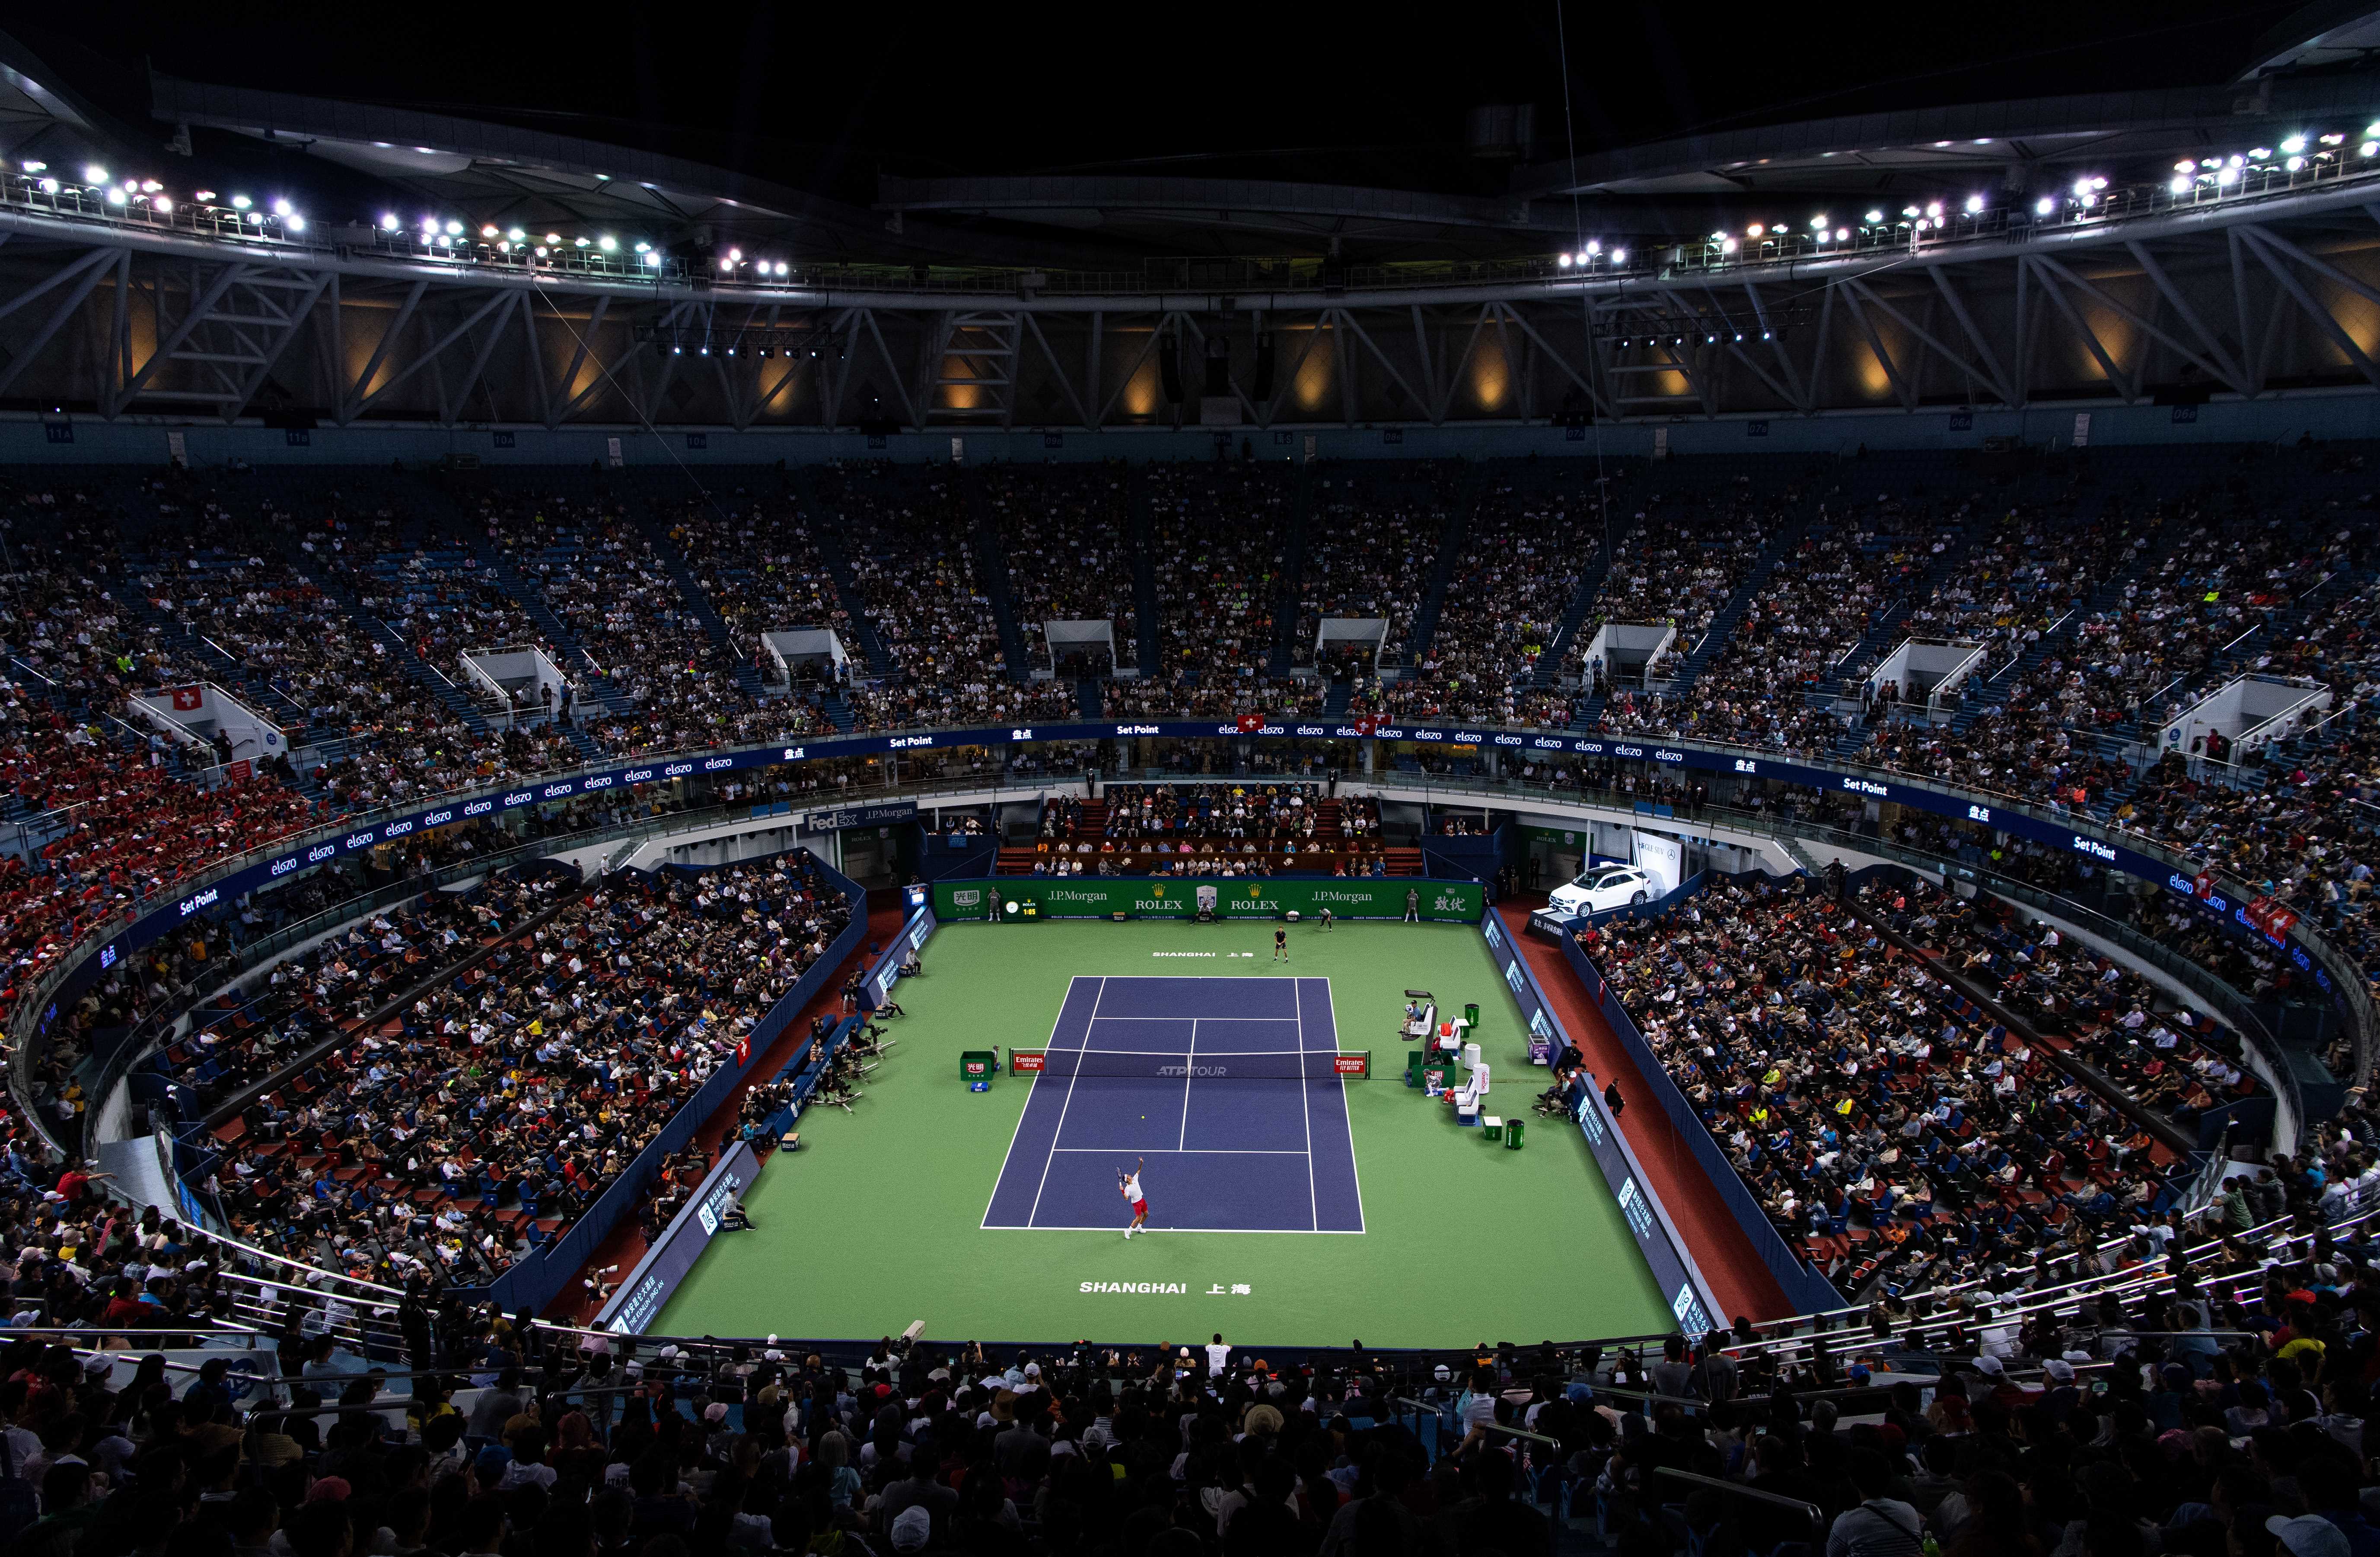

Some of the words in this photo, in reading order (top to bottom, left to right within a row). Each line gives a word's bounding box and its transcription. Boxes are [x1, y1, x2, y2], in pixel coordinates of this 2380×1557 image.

[48, 428, 71, 439] 11A
[289, 433, 307, 442] 11B
[495, 436, 513, 444] 10A
[1013, 729, 1032, 739] 盘点
[908, 737, 932, 746] Point
[785, 748, 804, 759] 盘点
[1735, 760, 1755, 772] 盘点
[1844, 778, 1860, 790] Set
[1862, 782, 1887, 795] Point
[866, 807, 913, 820] J.P.Morgan
[808, 811, 858, 831] FedEx
[1655, 846, 1664, 855] SUV
[2074, 836, 2090, 851] Set
[2091, 843, 2115, 860] Point
[909, 887, 925, 895] FedEx
[180, 898, 194, 915] Set
[195, 889, 218, 907] Point
[956, 892, 978, 902] 光明
[1048, 891, 1107, 905] J.P.Morgan
[1312, 891, 1372, 904] J.P.Morgan
[1135, 900, 1183, 909] ROLEX
[1231, 901, 1279, 910] ROLEX
[1434, 895, 1466, 911] 致优
[1156, 1066, 1188, 1076] ATP
[1190, 1066, 1227, 1075] TOUR
[736, 1177, 741, 1186] AN
[1079, 1282, 1186, 1294] SHANGHAI
[1206, 1283, 1251, 1294] 上海
[624, 1276, 656, 1319] 静安昆仑大酒店
[629, 1315, 637, 1327] THE
[636, 1298, 651, 1318] KUNLUN
[650, 1287, 659, 1301] JING
[657, 1279, 664, 1290] AN
